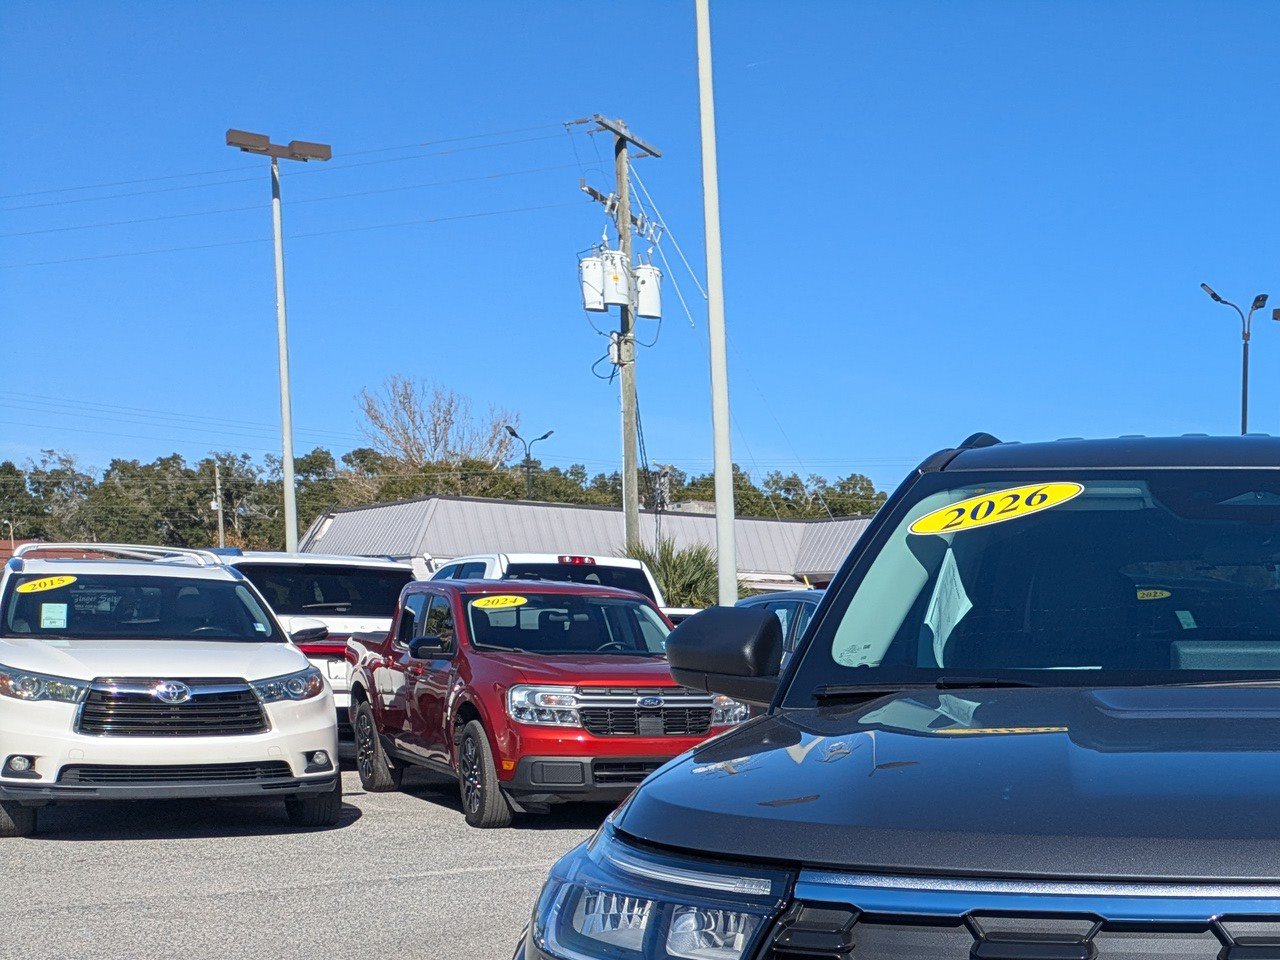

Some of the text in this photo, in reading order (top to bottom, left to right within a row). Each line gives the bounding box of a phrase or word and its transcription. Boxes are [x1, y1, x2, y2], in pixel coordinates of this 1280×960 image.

[941, 486, 1049, 530] 2026
[28, 578, 65, 591] 2015
[483, 598, 518, 607] 2024
